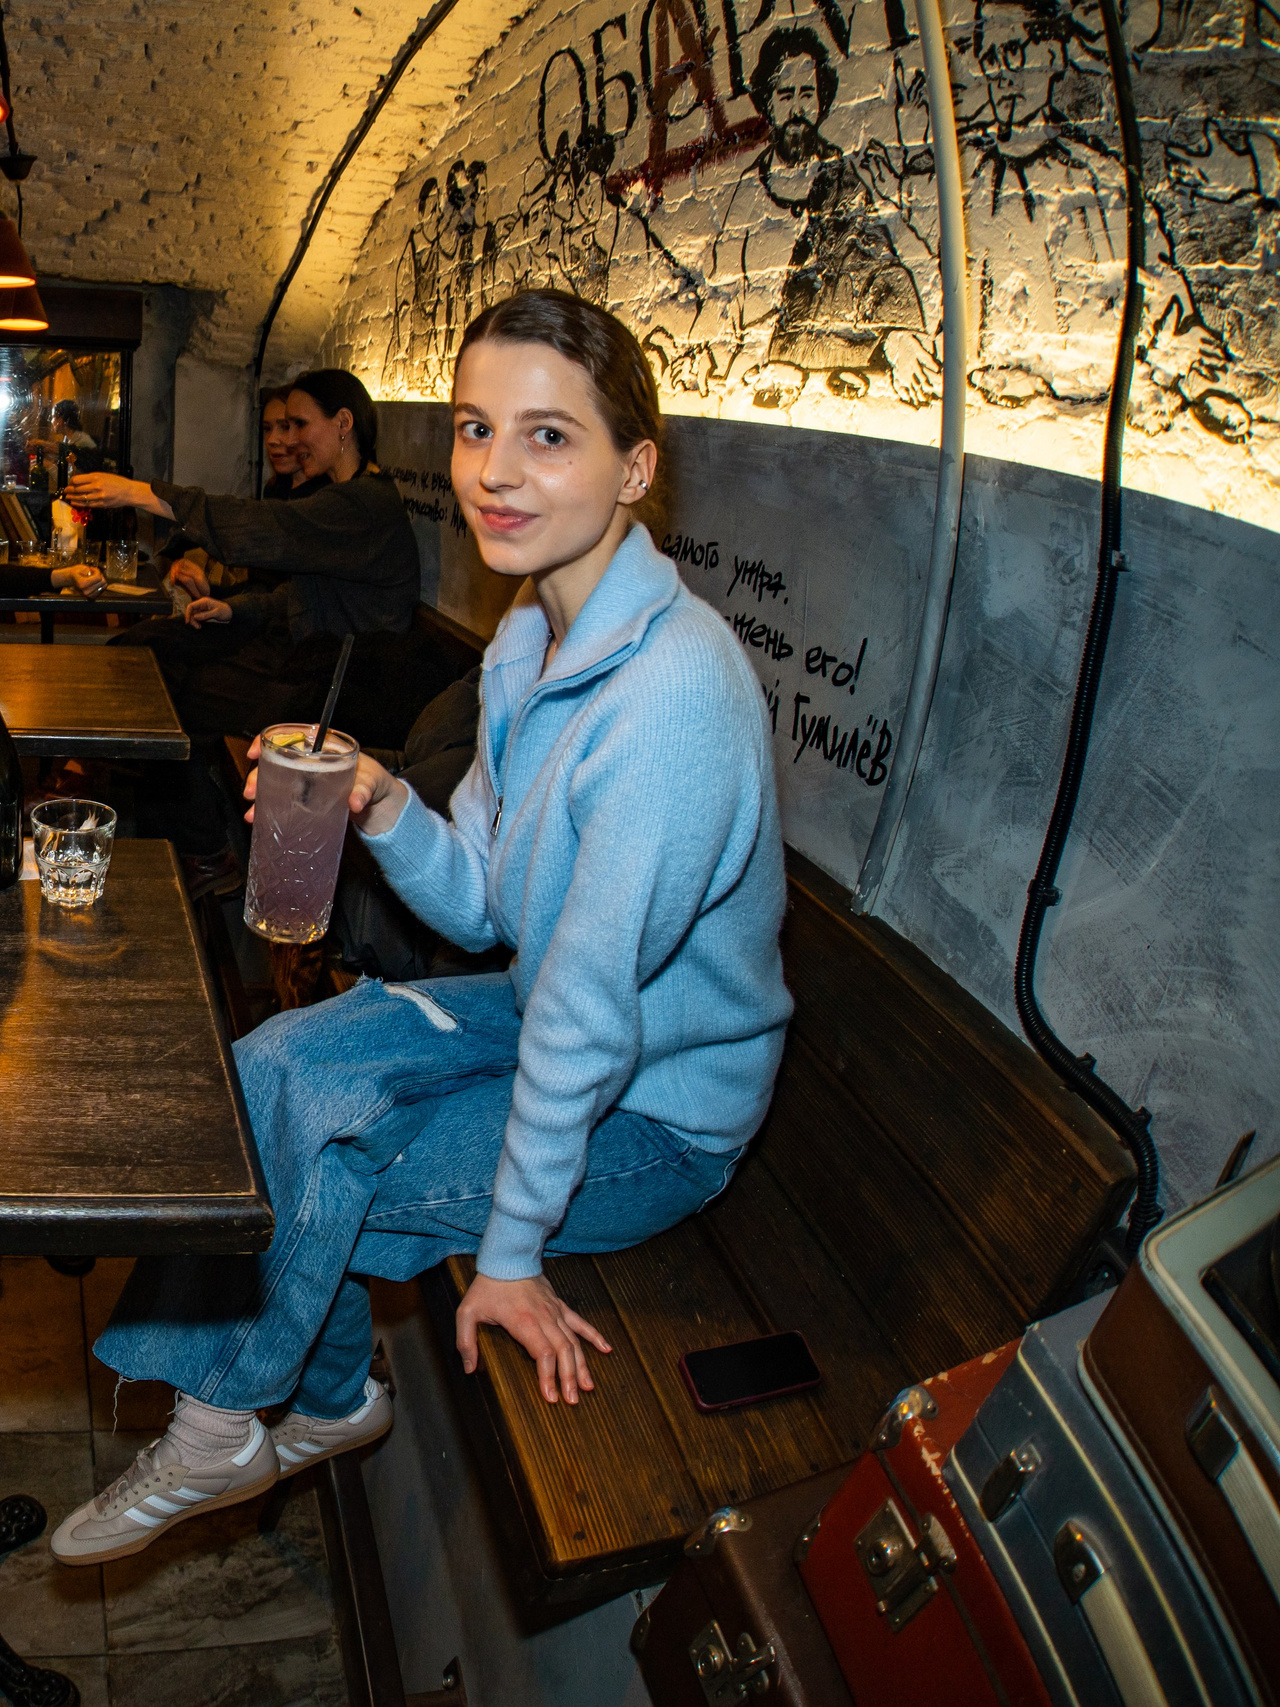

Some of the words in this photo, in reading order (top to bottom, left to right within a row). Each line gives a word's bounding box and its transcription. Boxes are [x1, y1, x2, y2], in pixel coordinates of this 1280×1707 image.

[661, 533, 719, 570] самого
[726, 555, 788, 605] утра.
[805, 637, 868, 695] его!
[791, 691, 892, 786] Гумилёв
